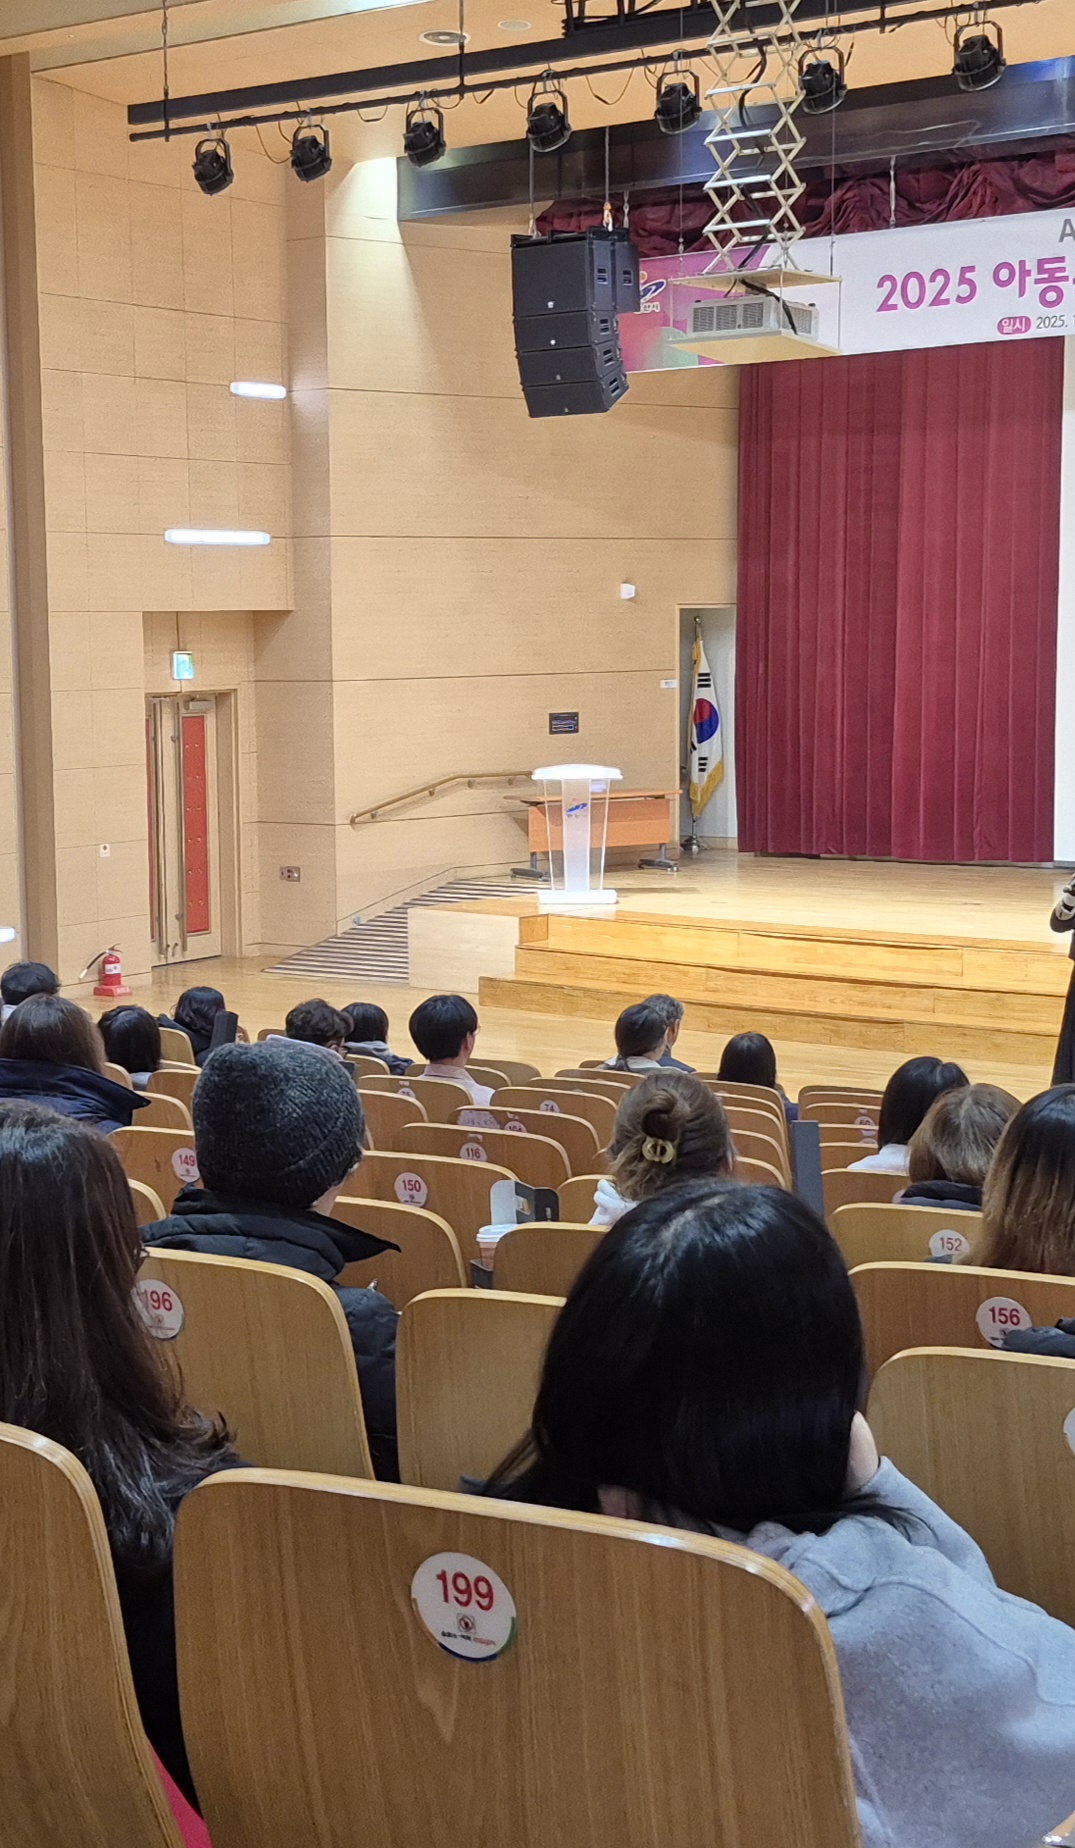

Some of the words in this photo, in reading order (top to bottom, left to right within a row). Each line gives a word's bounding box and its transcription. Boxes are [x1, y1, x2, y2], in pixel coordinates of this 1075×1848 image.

[876, 265, 978, 313] 2025
[1001, 317, 1026, 334] 일시
[1036, 315, 1069, 330] 2025.
[178, 1154, 196, 1167] 149
[465, 1147, 481, 1159] 116
[402, 1179, 421, 1193] 150
[940, 1236, 962, 1252] 152
[989, 1306, 1021, 1327] 156
[436, 1568, 495, 1612] 199
